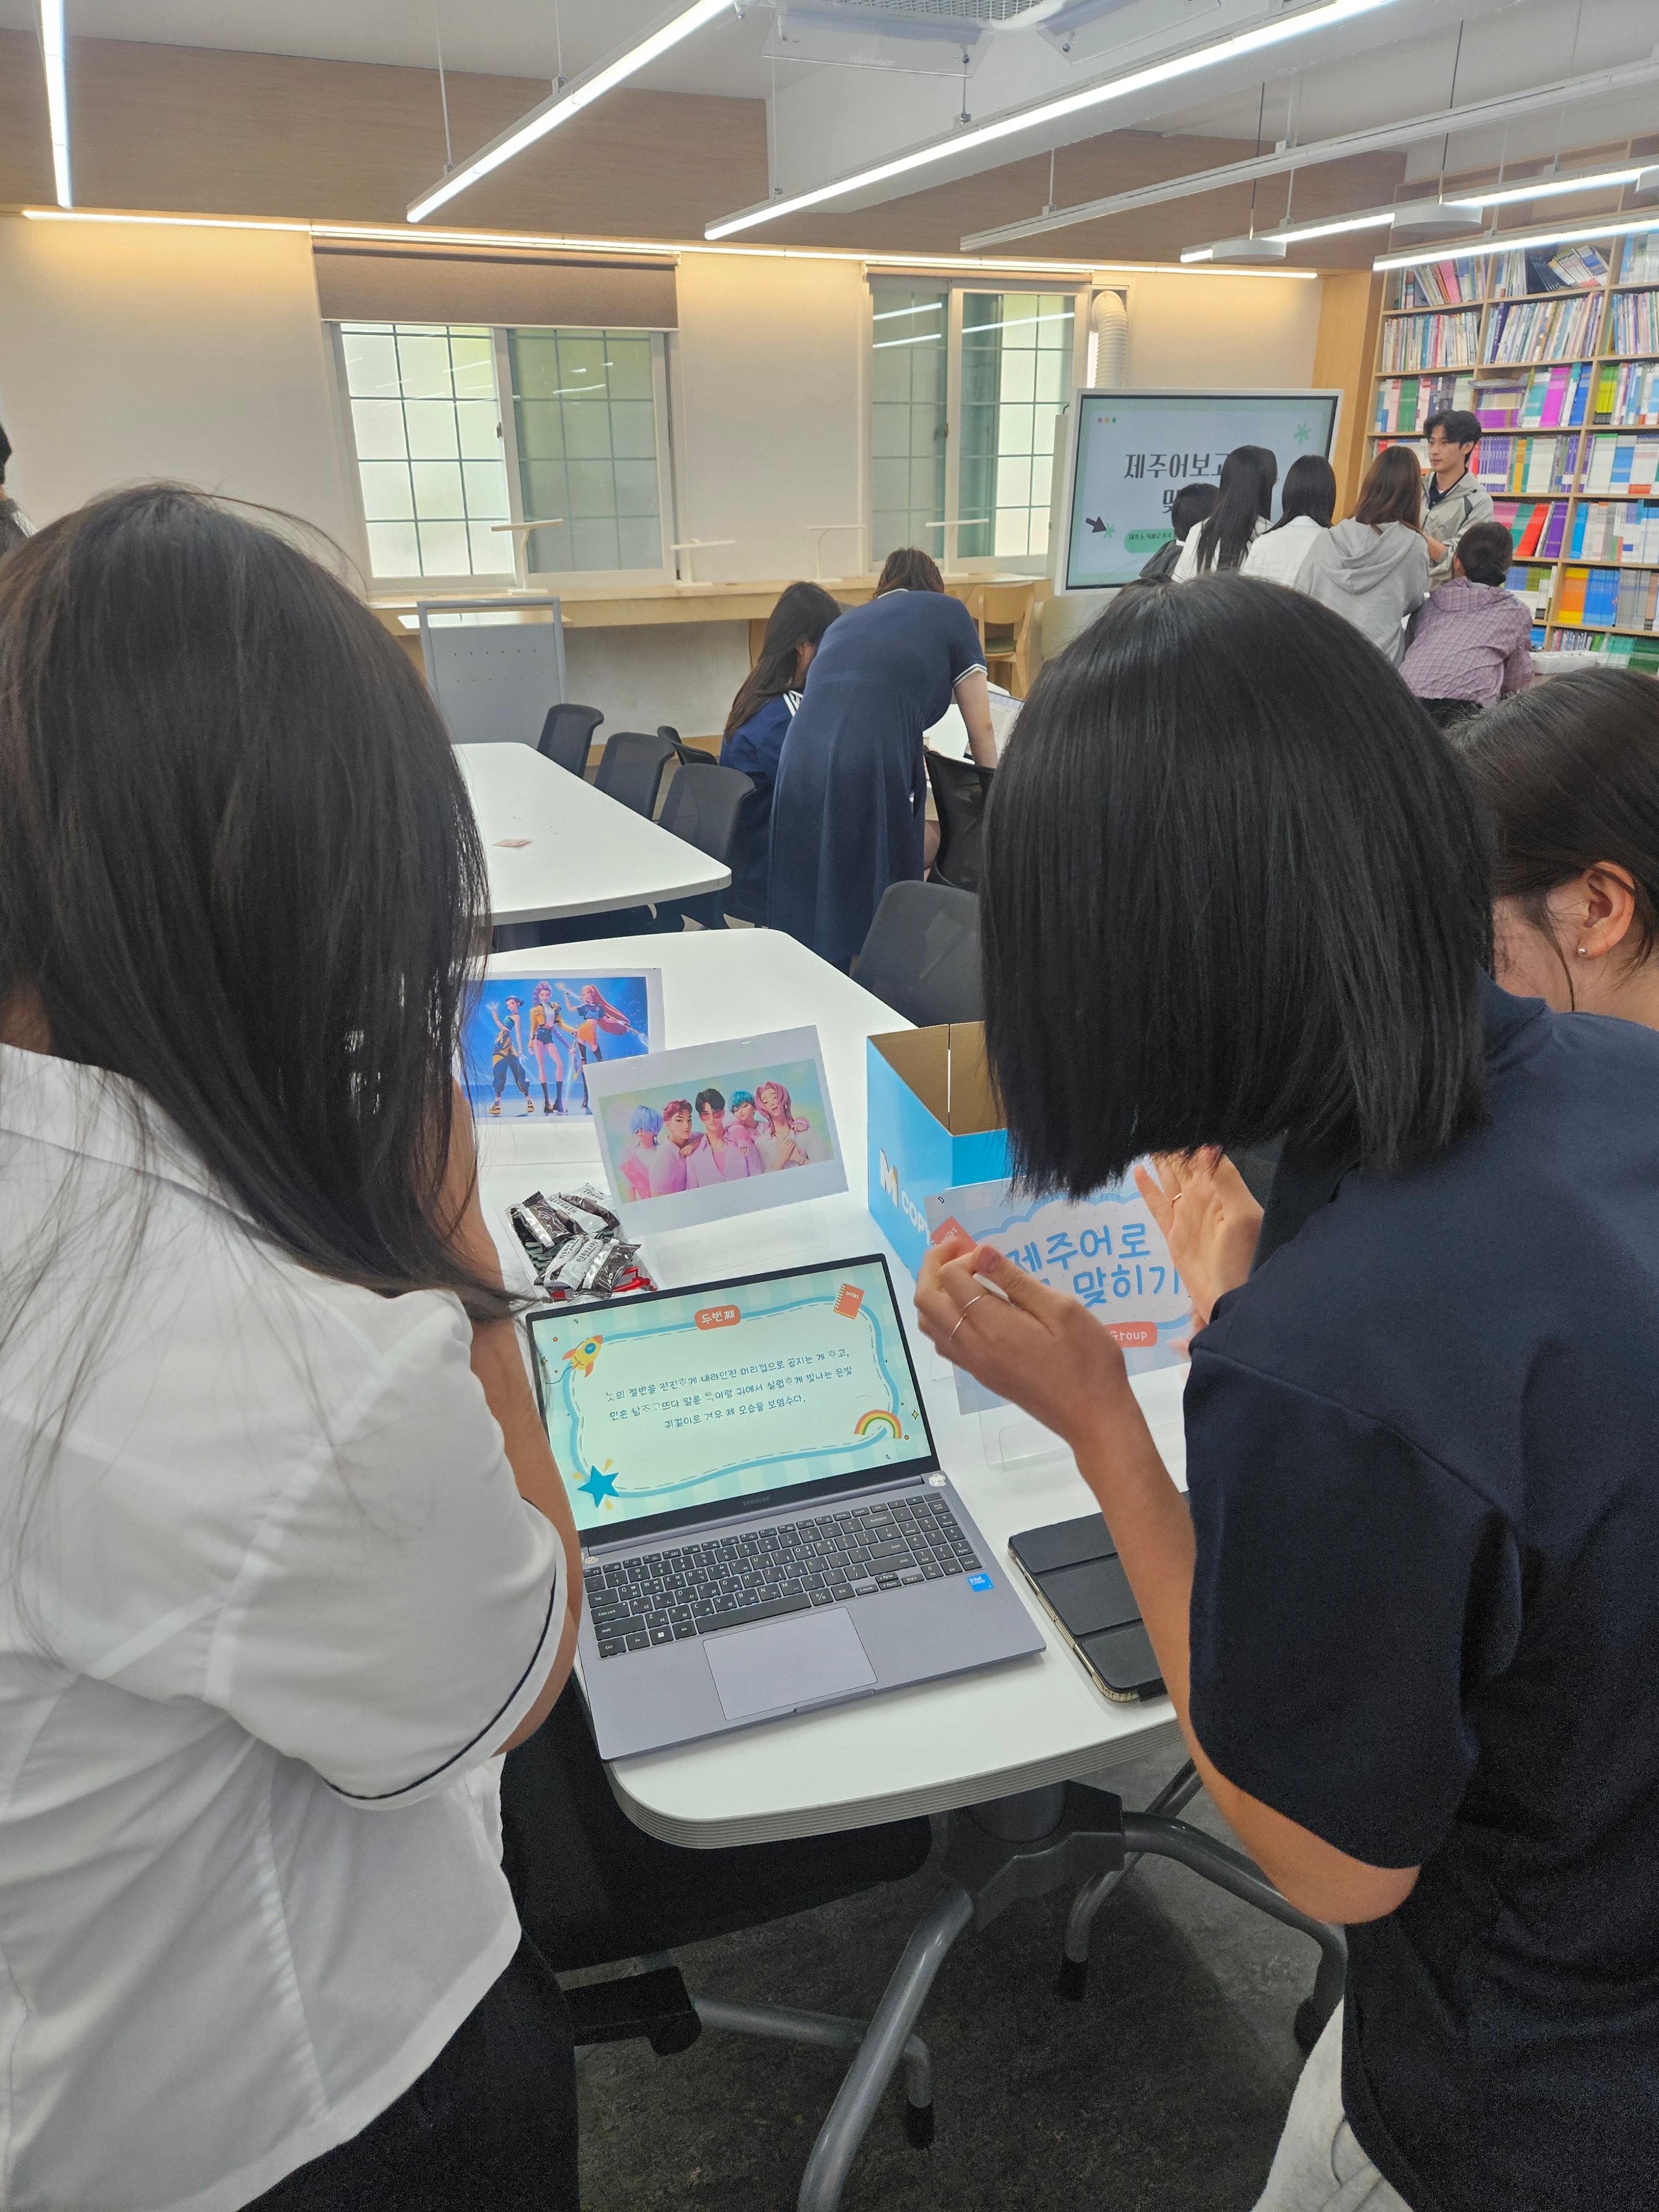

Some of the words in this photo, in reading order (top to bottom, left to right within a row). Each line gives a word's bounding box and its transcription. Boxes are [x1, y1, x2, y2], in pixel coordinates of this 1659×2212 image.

[1123, 453, 1228, 479] 제주어보고
[941, 1227, 958, 1245] NOTES
[1006, 1223, 1151, 1272] 제주어로
[1073, 1264, 1180, 1308] 맞히기
[1110, 1329, 1147, 1342] Group
[629, 1384, 656, 1397] 절반을
[701, 1369, 737, 1382] 내려안진
[787, 1355, 813, 1368] 곱지는
[816, 1353, 825, 1361] 게
[736, 1383, 763, 1396] 귀에서
[806, 1371, 832, 1383] 빛나는
[836, 1365, 853, 1378] 은빛
[664, 1414, 702, 1429] 귀걸이로
[704, 1410, 723, 1421] 겨우
[726, 1408, 735, 1416] 제
[739, 1402, 764, 1415] 모습을
[743, 1496, 770, 1506] SAMSUNG
